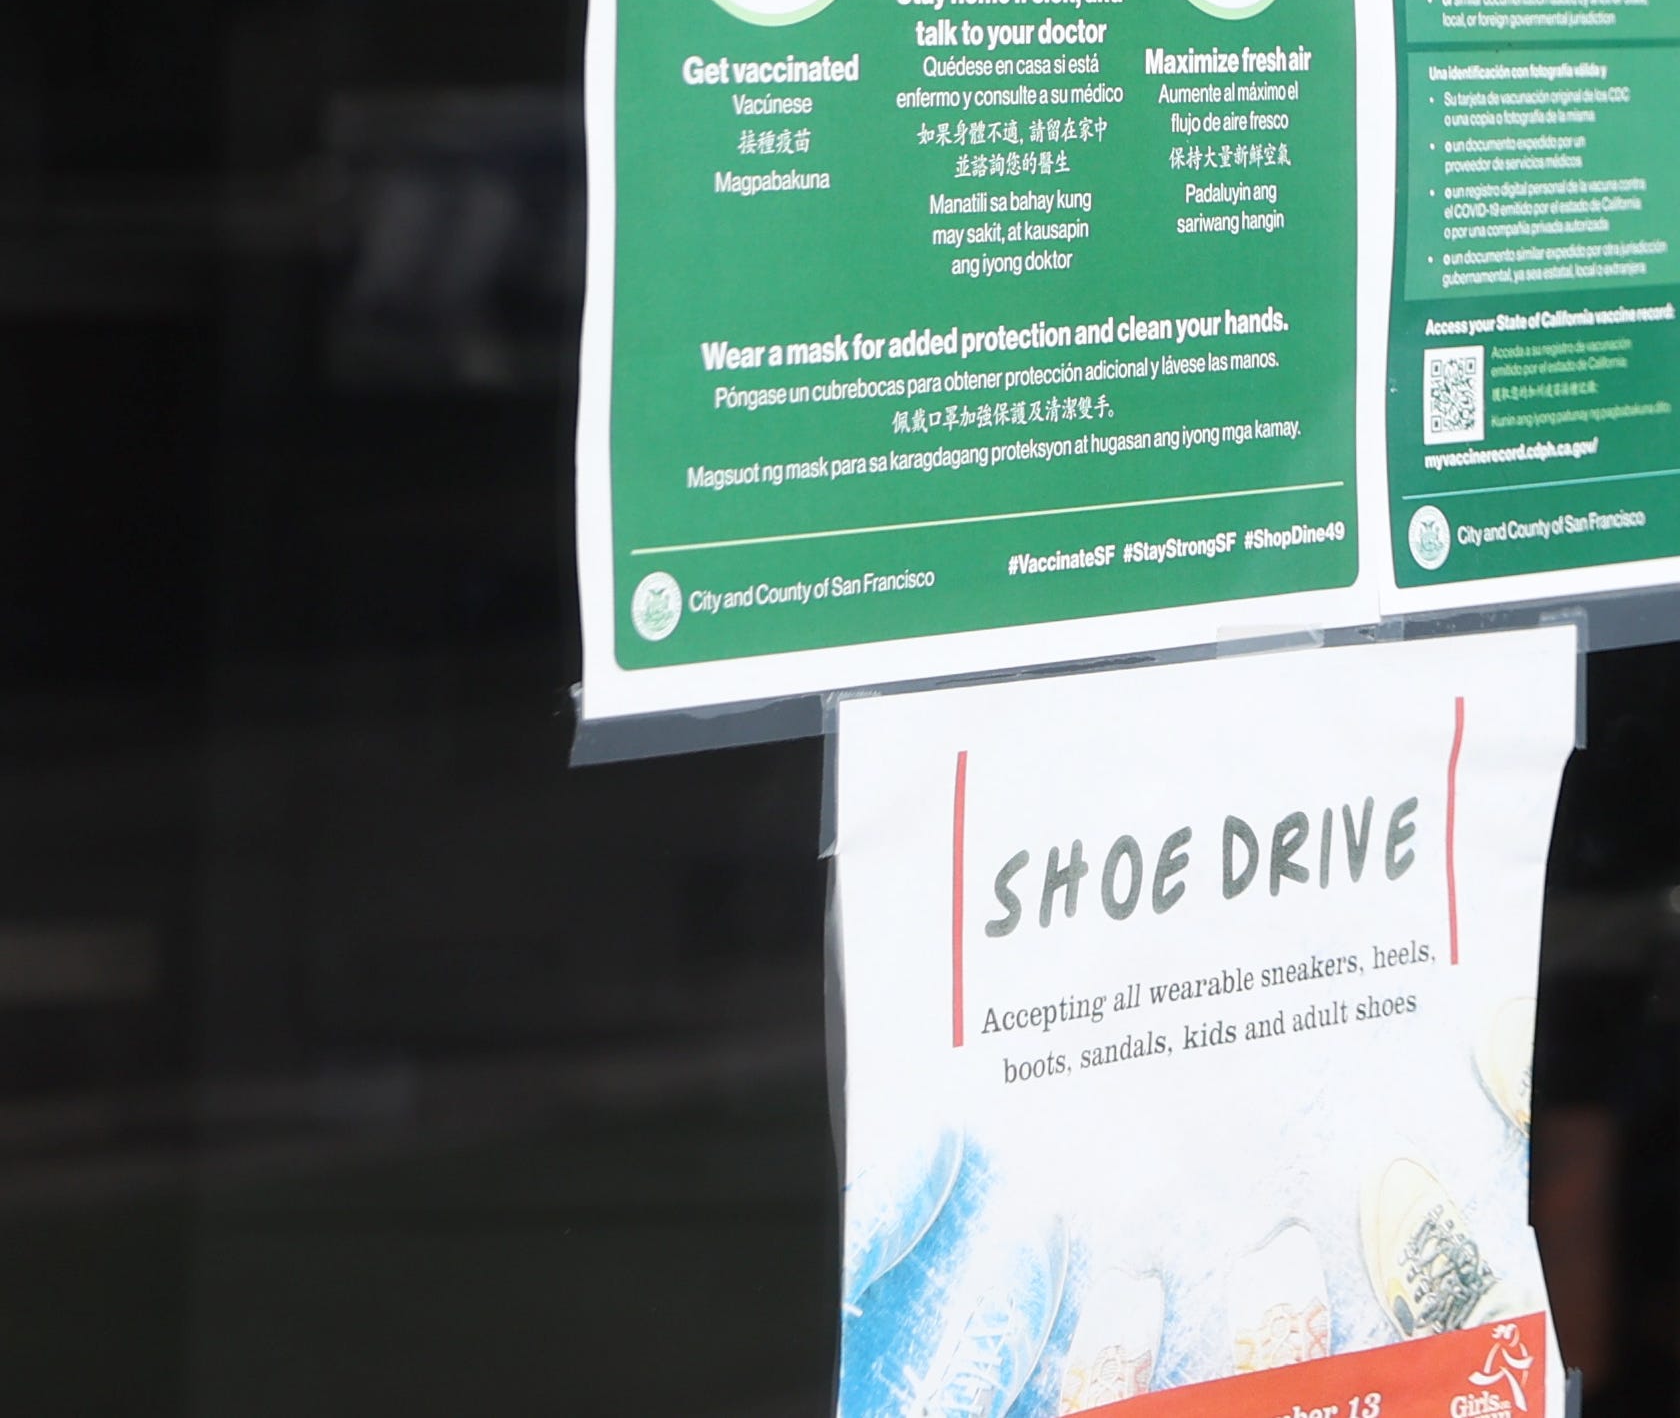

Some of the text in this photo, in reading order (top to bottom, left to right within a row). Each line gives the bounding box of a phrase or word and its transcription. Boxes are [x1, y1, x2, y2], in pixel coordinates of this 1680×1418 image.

[915, 17, 1107, 51] talk to your doctor
[682, 53, 859, 85] Get vaccinated
[922, 52, 1099, 77] Quédese en casa si está
[1145, 44, 1312, 74] Maximize fresh air
[732, 93, 813, 115] Vacúnese
[896, 82, 1123, 110] enfermo y consulte a su médico
[1158, 80, 1298, 103] Aumente al máximo el
[1170, 110, 1289, 136] flujo de aire fresco
[737, 130, 811, 154] 接種疫苗
[1168, 143, 1291, 171] 保持大量新鮮空氣
[714, 168, 830, 196] Magpabakuna
[1185, 181, 1277, 205] Padaluyin ang
[929, 189, 1092, 214] Manatili sa bahay kung
[932, 218, 1089, 248] may sakit, at kausapin
[1176, 209, 1284, 235] sariwang hangin
[951, 249, 1073, 278] ang iyong doktor
[1425, 319, 1468, 335] Access
[1468, 318, 1496, 336] your
[1496, 314, 1528, 331] State
[1527, 312, 1541, 329] of
[1540, 309, 1595, 328] California
[1593, 306, 1636, 323] vaccine
[700, 306, 1289, 371] Wear a mask for added protection and clean your hands.
[1457, 509, 1646, 546] City and County of San Francisco
[1008, 520, 1345, 575] #VaccinateSF #StayStrongSF #ShopDine49
[688, 569, 935, 614] City and County of San Francisco
[984, 796, 1419, 939] SHOE DRIVE
[981, 941, 1435, 1034] Accepting all wearable sneakers, heels,
[1003, 995, 1417, 1083] boots, sandals, kids and adult shoes
[1347, 1392, 1382, 1418] 13
[1450, 1390, 1501, 1418] Girls
